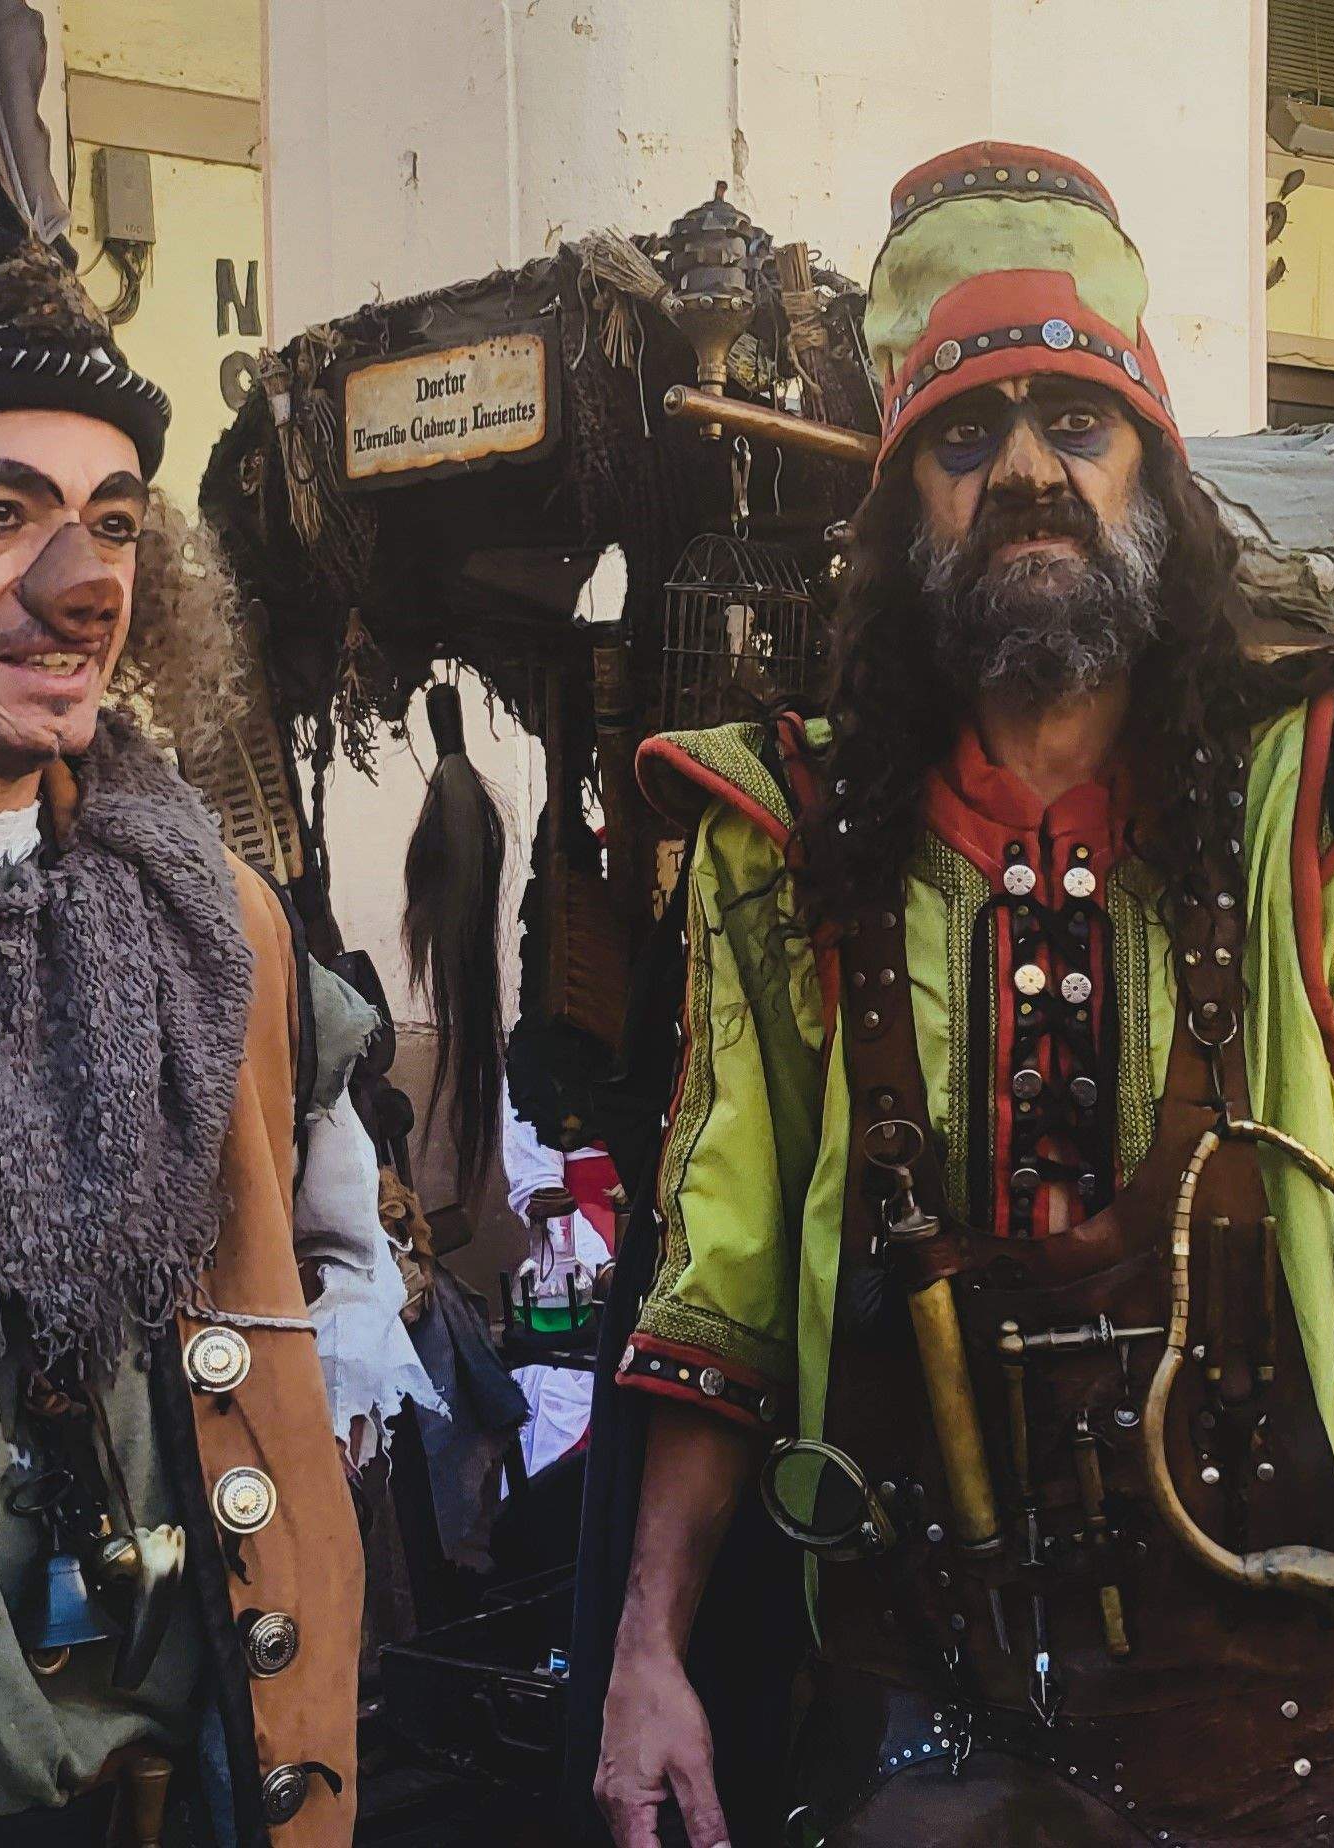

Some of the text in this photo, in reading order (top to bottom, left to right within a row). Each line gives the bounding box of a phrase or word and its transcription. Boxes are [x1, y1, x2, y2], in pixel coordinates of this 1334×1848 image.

[416, 371, 467, 403] Doctor
[410, 415, 456, 444] Caduco
[458, 417, 468, 438] y
[472, 402, 536, 431] Lucientes
